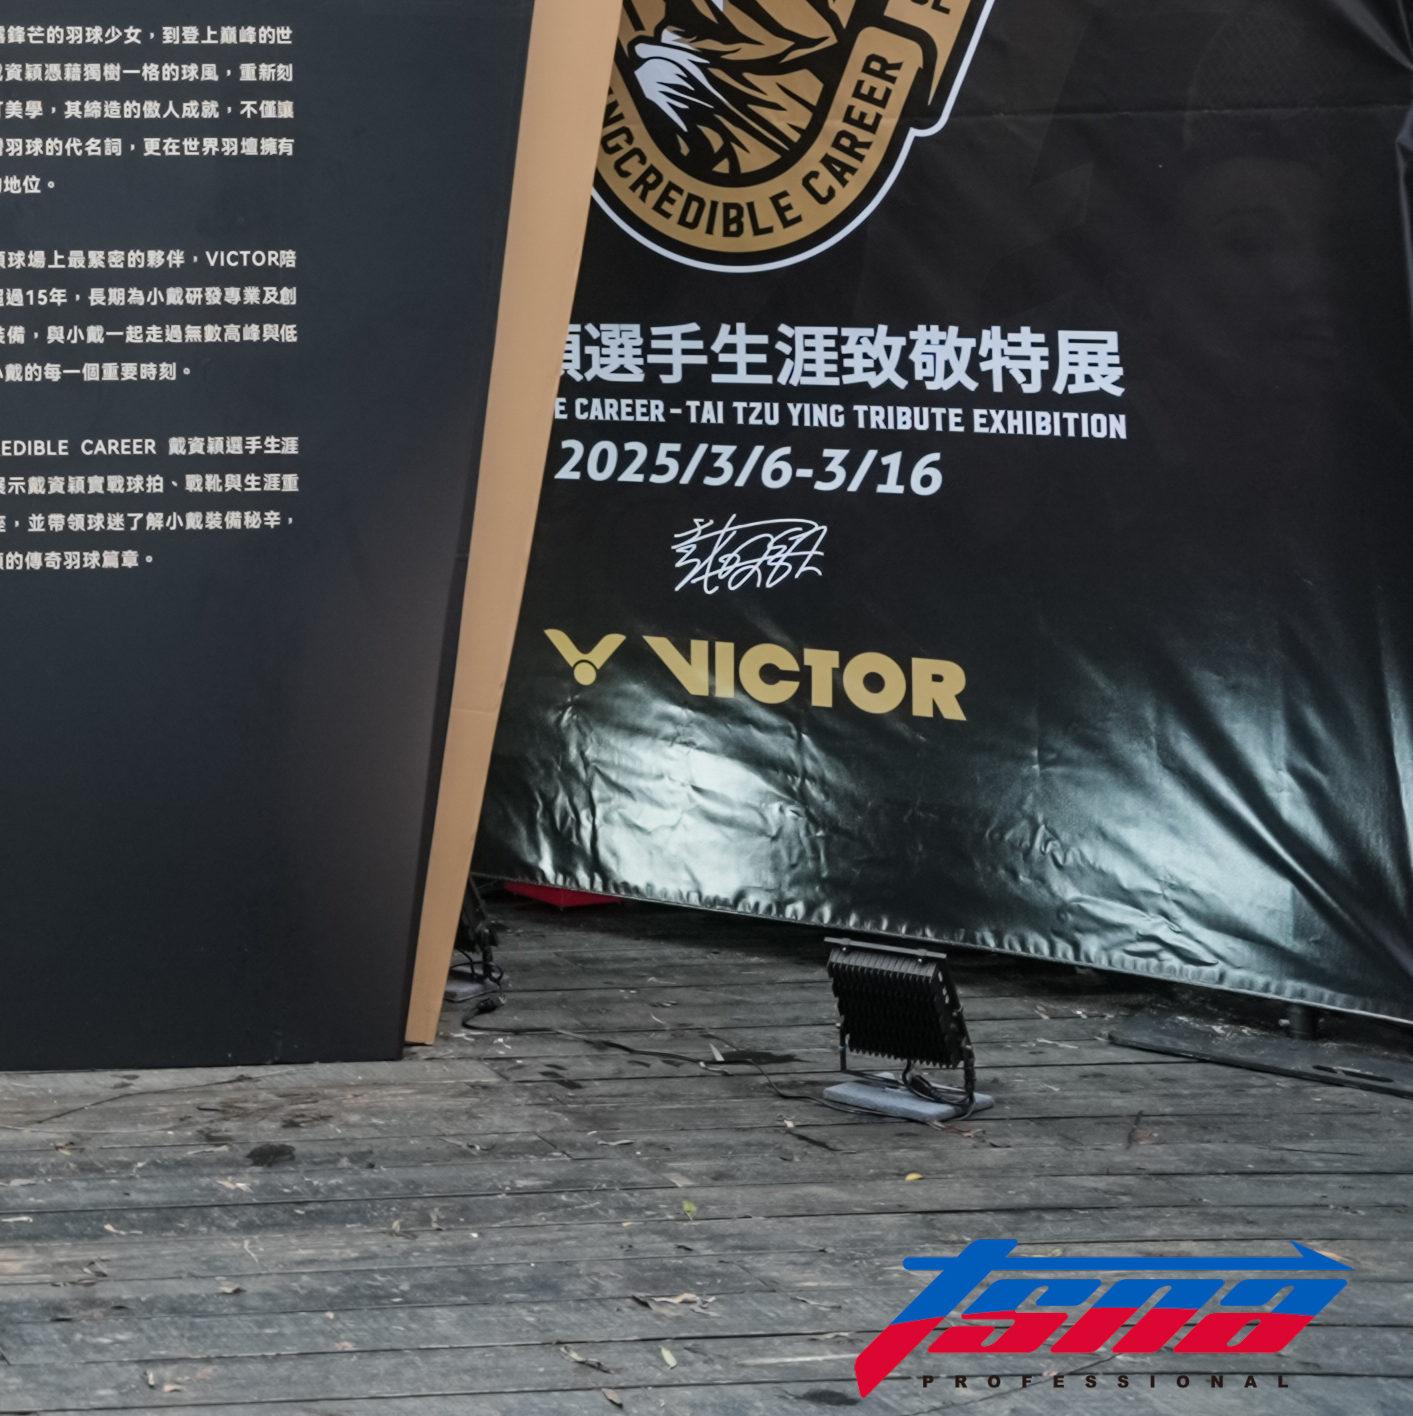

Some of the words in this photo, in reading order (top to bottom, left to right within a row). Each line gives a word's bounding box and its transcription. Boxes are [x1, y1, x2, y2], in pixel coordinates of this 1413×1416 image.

[600, 86, 802, 237] NGCREDIBLE
[802, 52, 904, 205] CAREER
[80, 439, 156, 455] CAREER
[575, 398, 666, 422] CAREER
[686, 400, 724, 424] TAI
[732, 402, 780, 426] TZU
[787, 403, 845, 428] YING
[853, 405, 964, 433] TRIBUTE
[972, 409, 1127, 440] EXHIBITION
[554, 439, 944, 496] 2025/3/6-3/16
[642, 634, 967, 721] VICTOR
